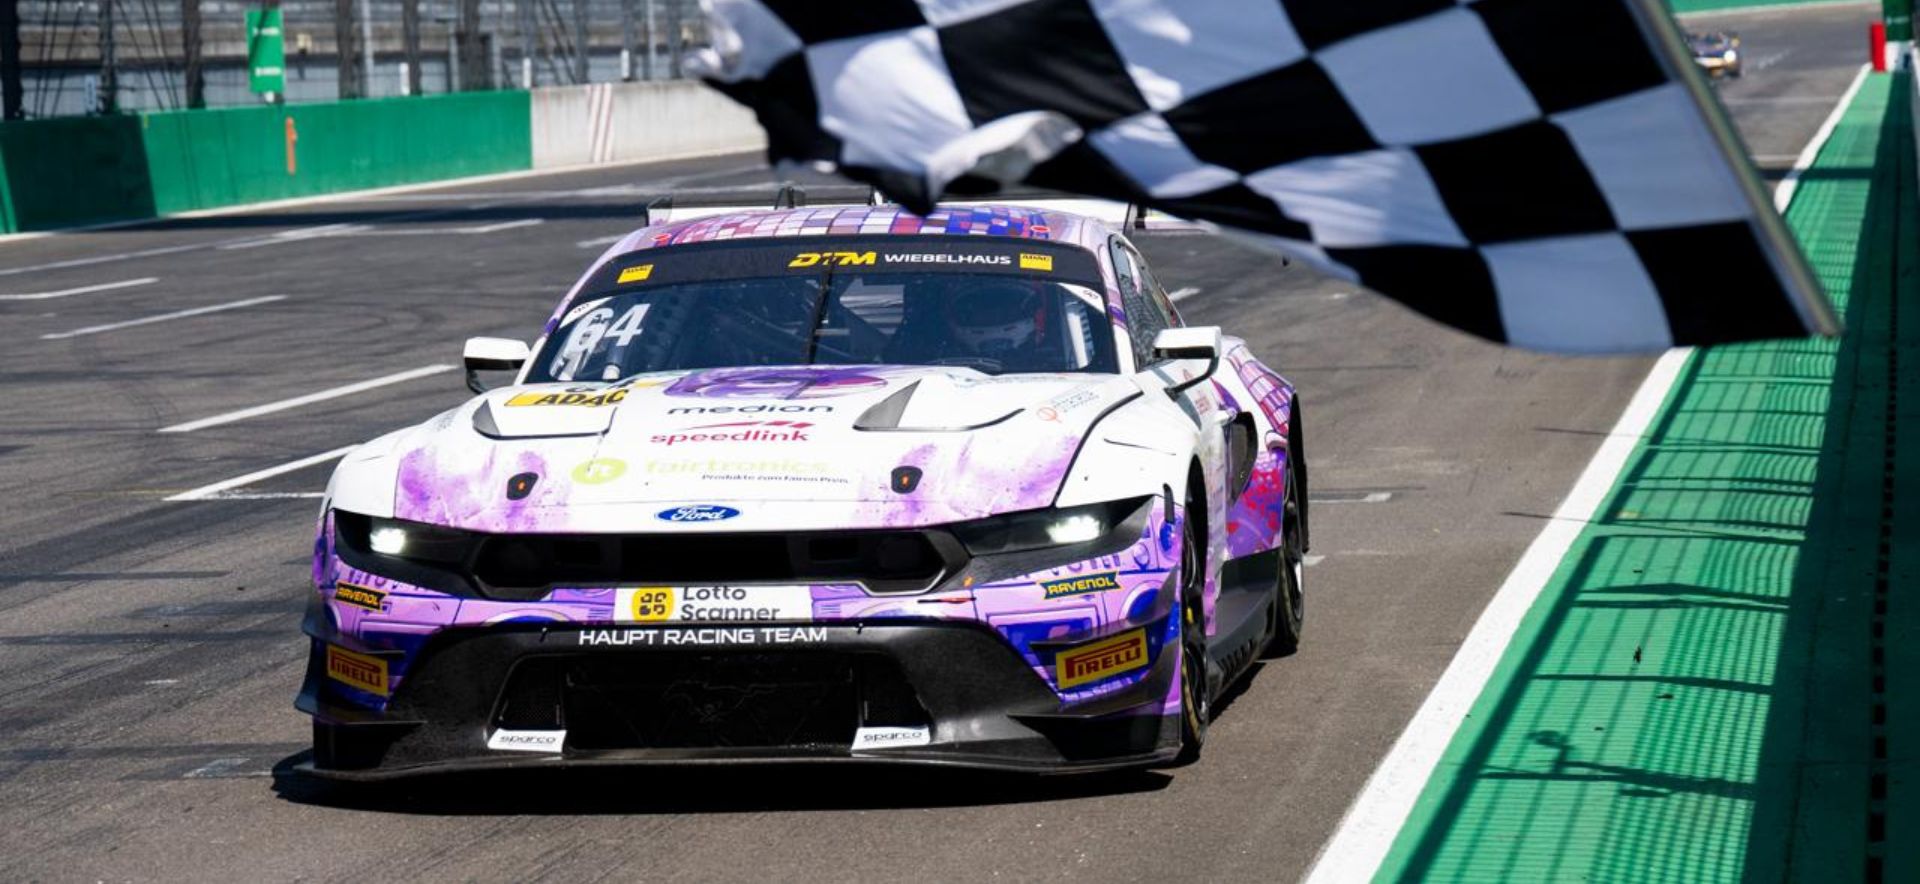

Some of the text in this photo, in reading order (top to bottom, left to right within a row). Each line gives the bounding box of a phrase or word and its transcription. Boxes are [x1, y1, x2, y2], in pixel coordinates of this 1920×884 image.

[788, 251, 1012, 268] DTM WIEBELHAUS
[534, 389, 629, 407] ADAC
[667, 404, 834, 415] medion
[650, 430, 809, 446] speedlink
[670, 506, 728, 521] Ford
[683, 586, 746, 601] Lotto
[1047, 577, 1115, 595] RAVENOL
[680, 604, 780, 622] Scanner
[578, 626, 828, 646] HAUPT RACING TEAM
[1065, 637, 1141, 681] PIRELLI
[330, 650, 382, 689] PIRELLI
[501, 735, 556, 745] sparco
[864, 732, 922, 742] sparco
